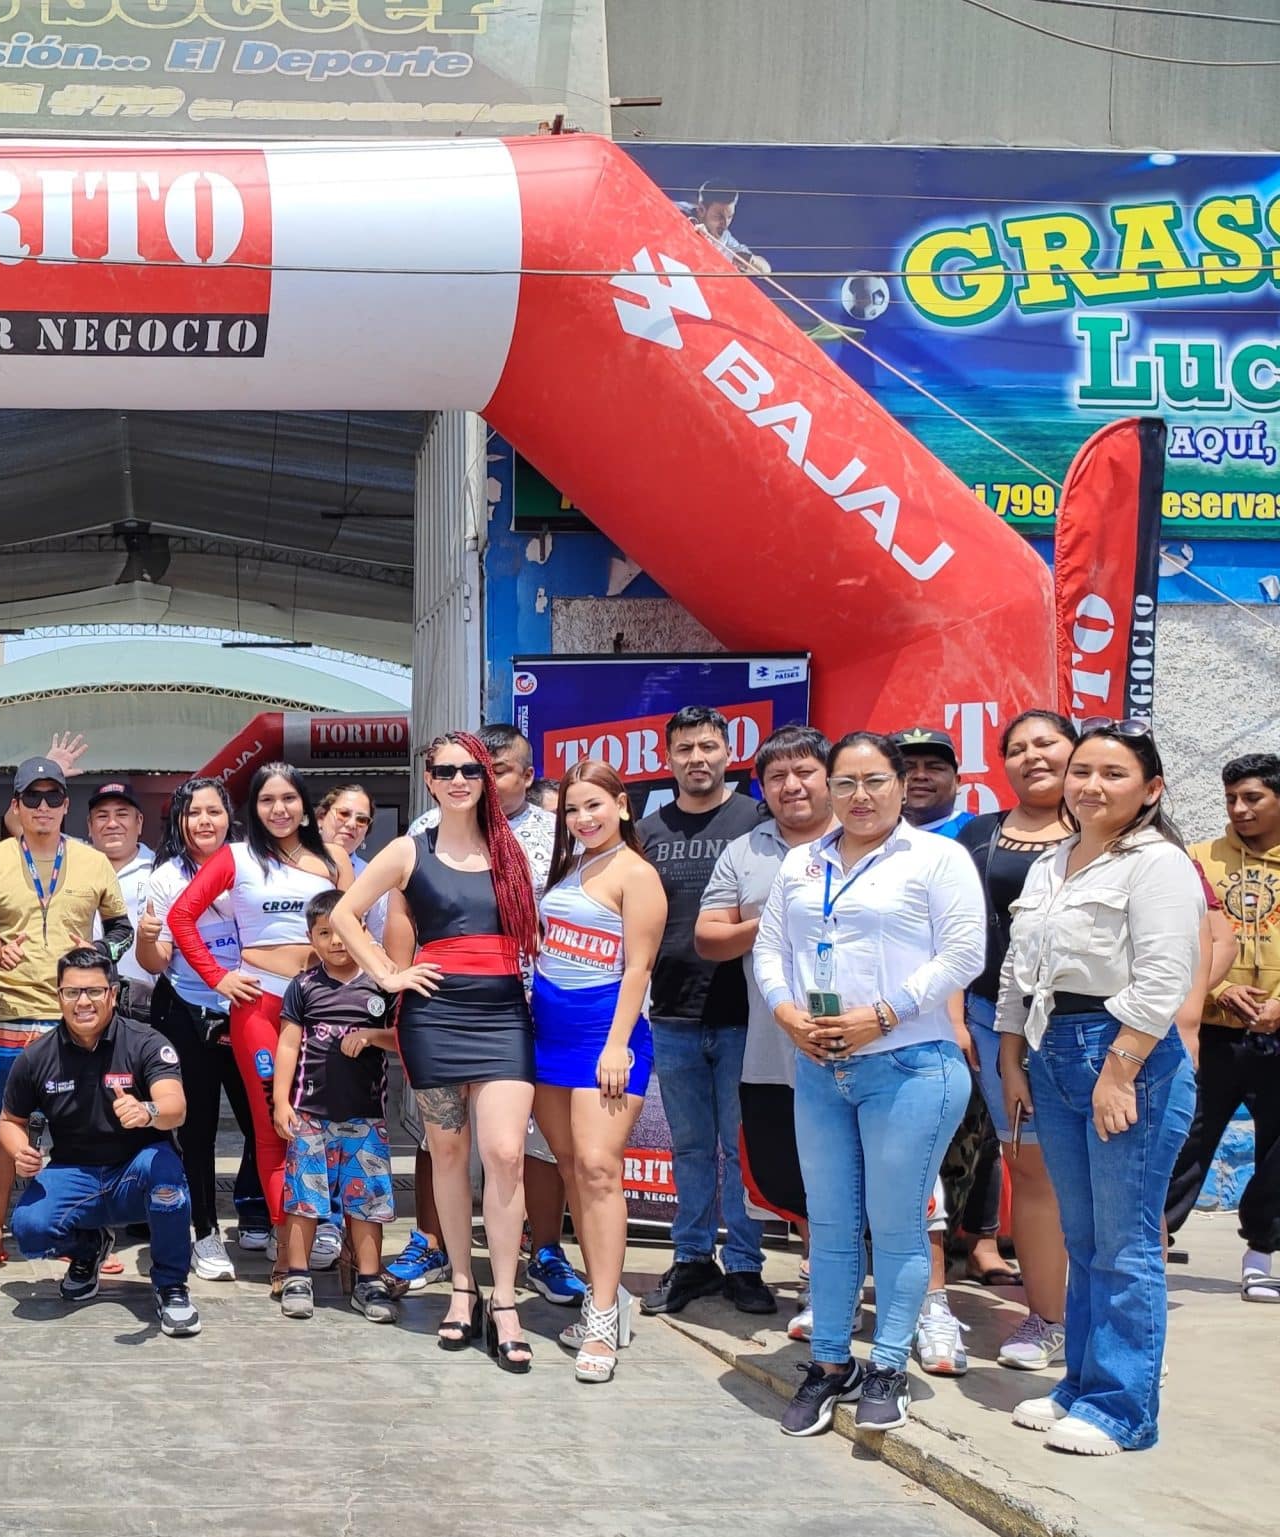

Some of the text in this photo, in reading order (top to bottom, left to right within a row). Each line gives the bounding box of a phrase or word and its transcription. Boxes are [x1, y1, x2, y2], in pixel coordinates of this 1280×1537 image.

[165, 37, 223, 73] El
[233, 41, 475, 82] Deporte
[902, 194, 1280, 327] GRAS
[35, 316, 259, 354] NEGOCIO
[701, 338, 956, 581] BAJAJ
[1168, 421, 1276, 465] AQUÍ,
[1129, 593, 1155, 722] EGOCIO
[315, 723, 404, 744] TORITO
[556, 715, 761, 777] TORO
[655, 838, 732, 862] BRON
[262, 900, 305, 912] CROM
[548, 923, 616, 957] TORITO
